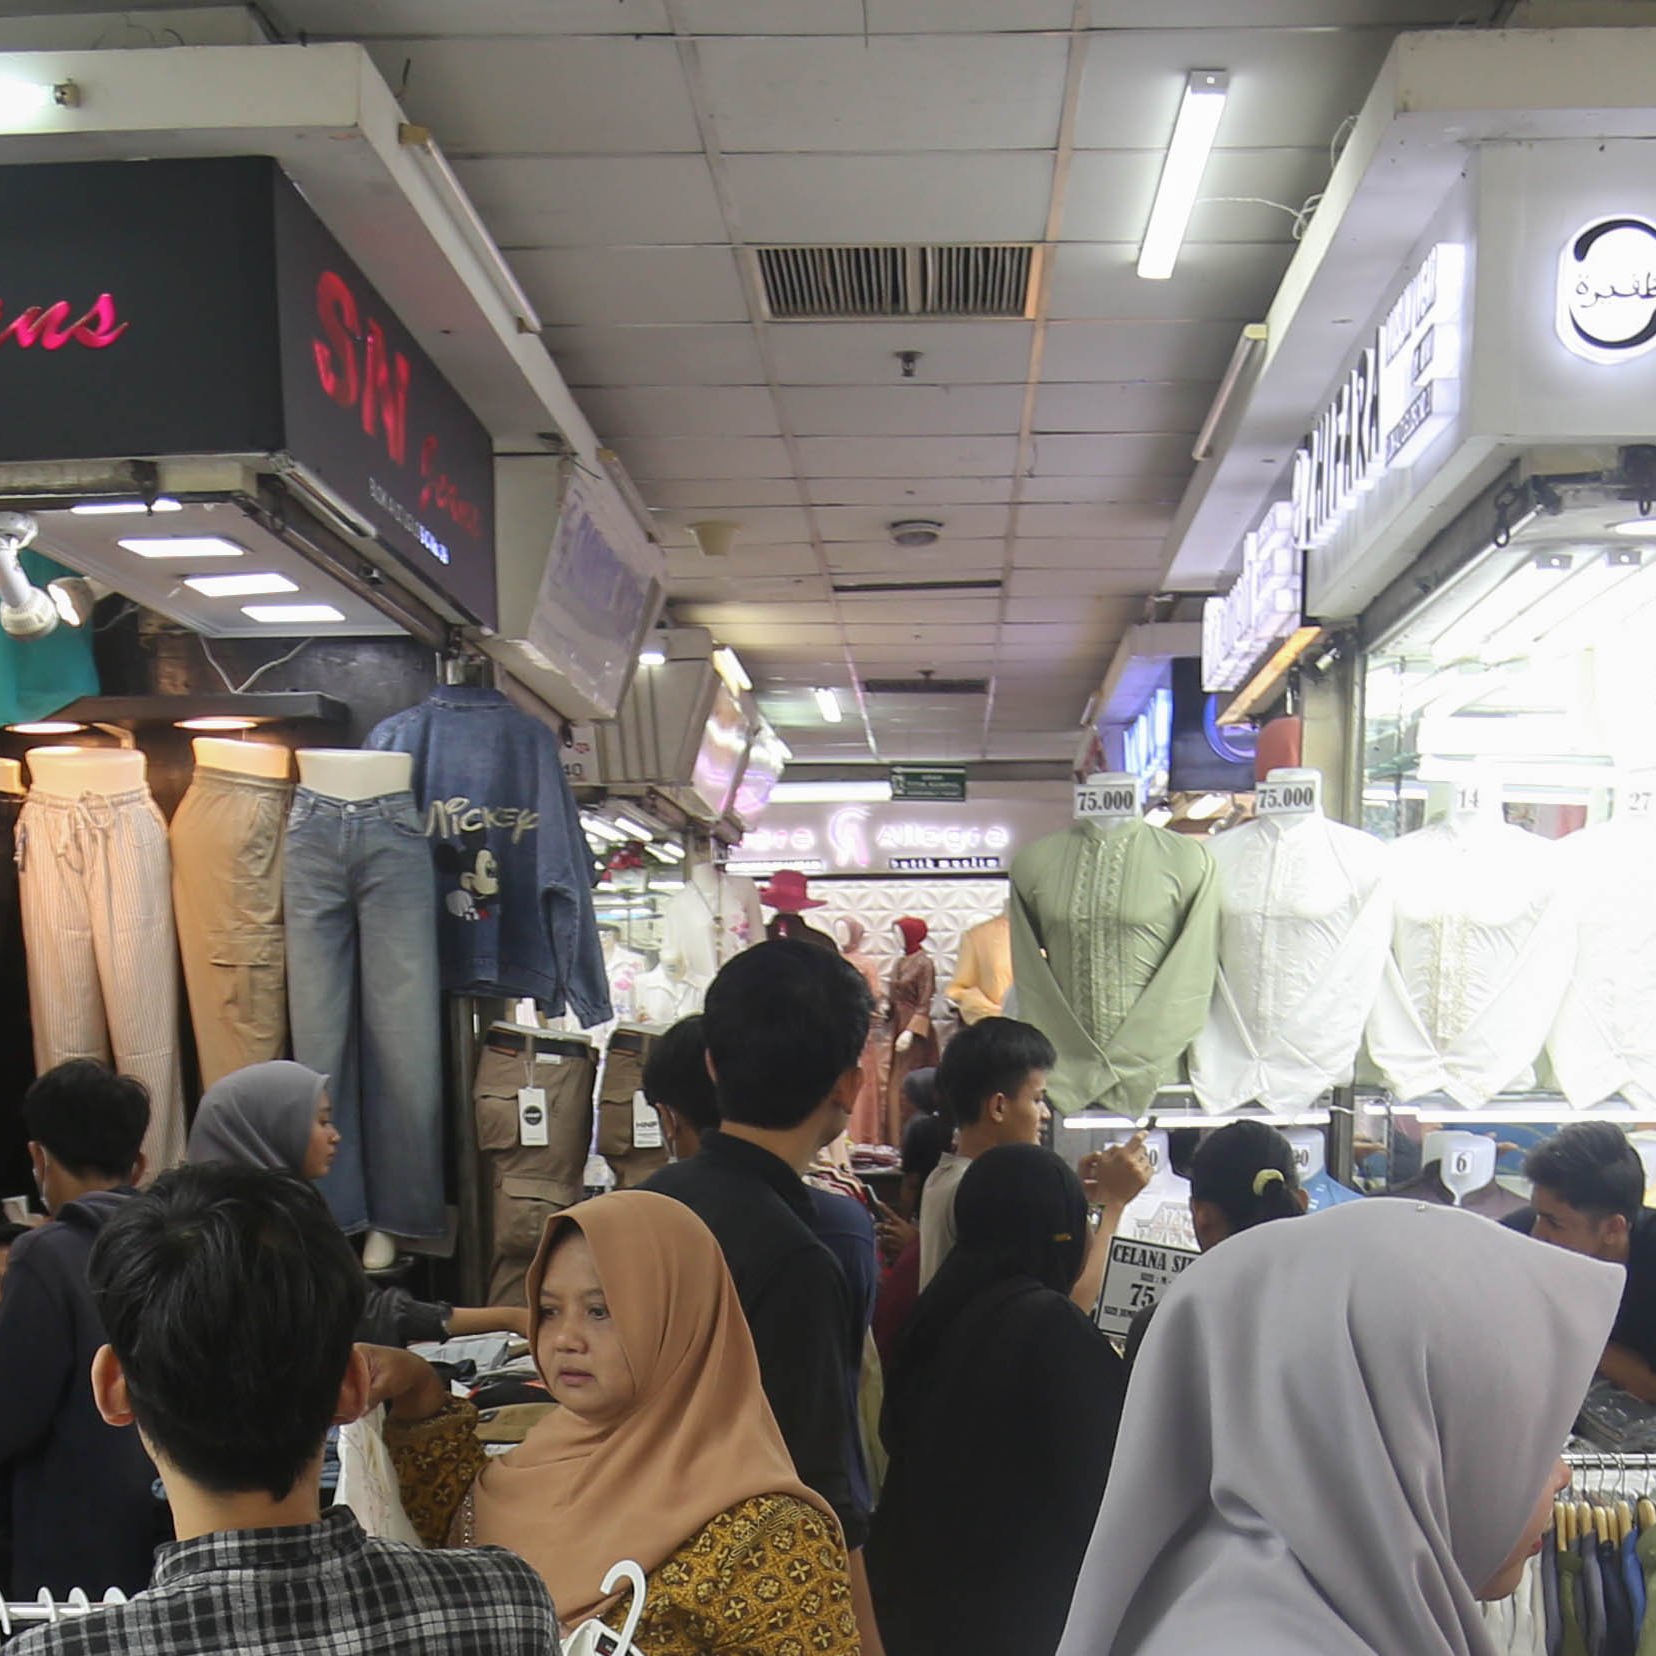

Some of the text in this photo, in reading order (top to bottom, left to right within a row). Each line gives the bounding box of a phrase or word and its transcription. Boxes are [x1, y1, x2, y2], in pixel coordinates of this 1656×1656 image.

[1077, 790, 1134, 811] 75.000
[1258, 786, 1314, 809] 75.000
[1456, 1154, 1468, 1172] 6
[1113, 1244, 1167, 1270] CELANA
